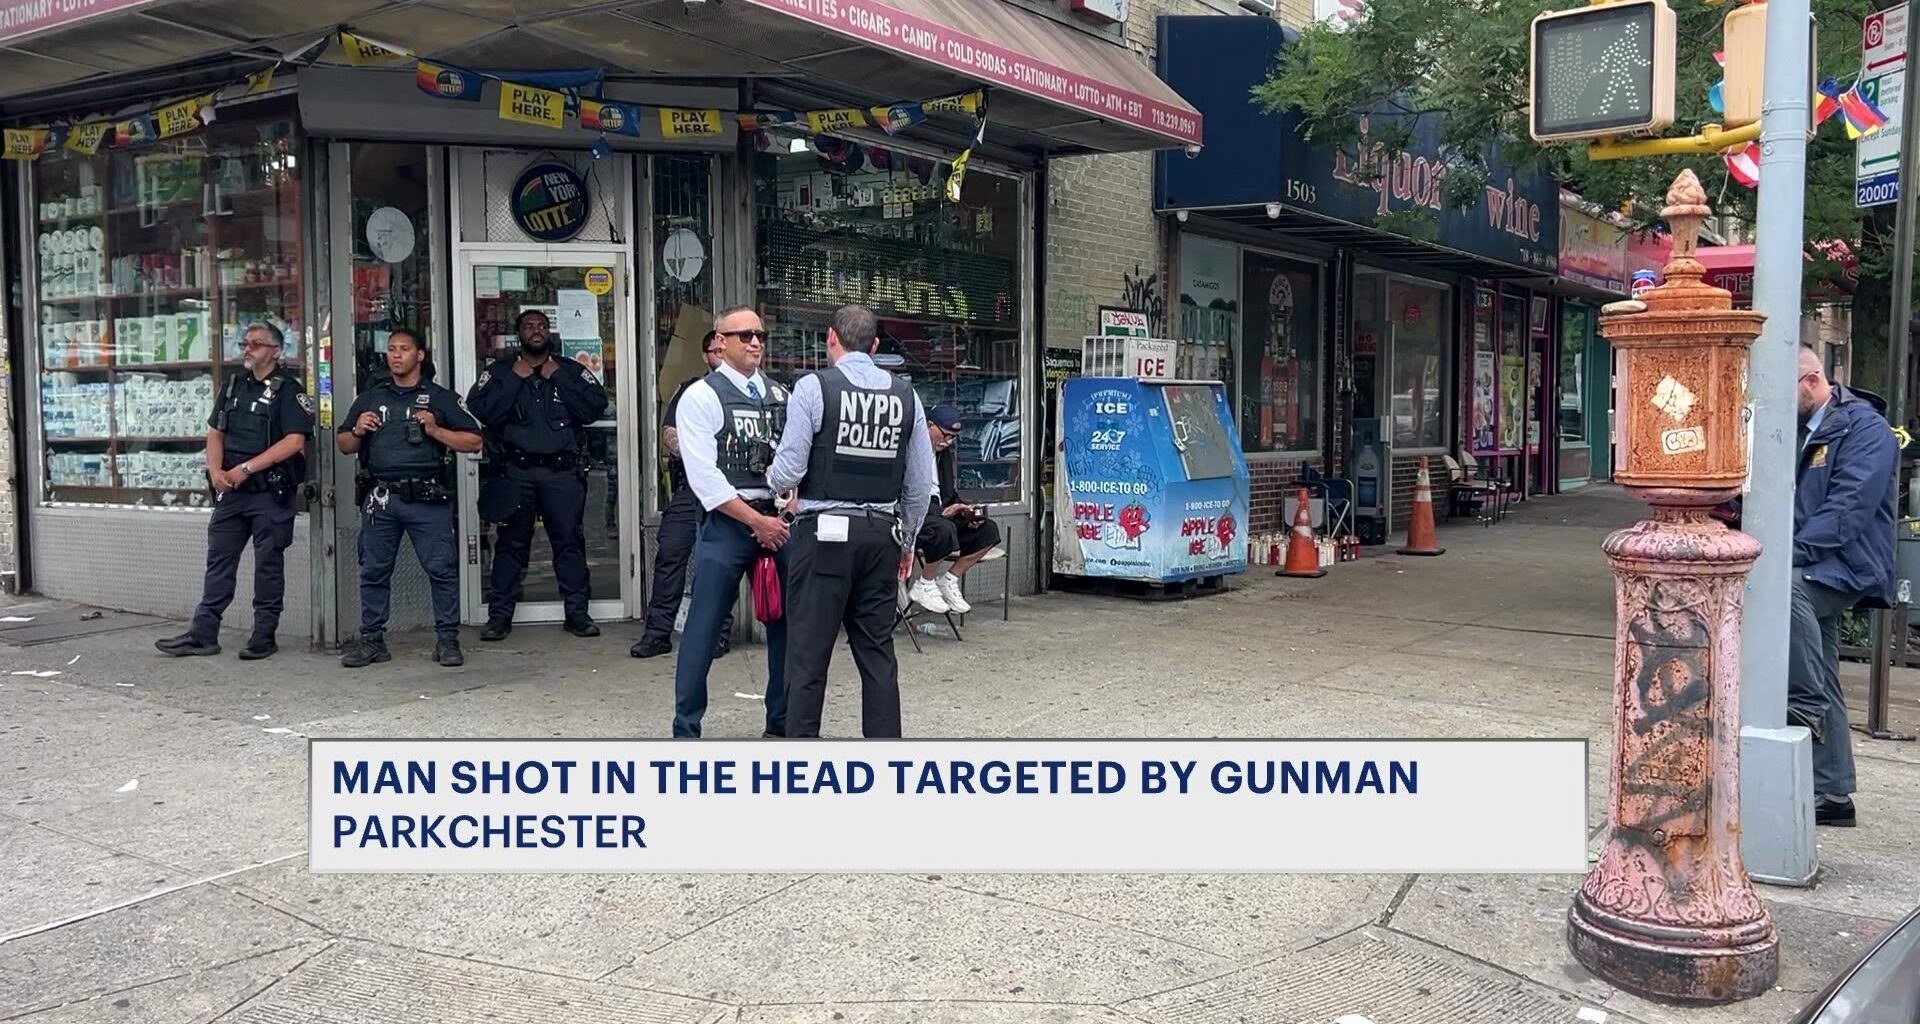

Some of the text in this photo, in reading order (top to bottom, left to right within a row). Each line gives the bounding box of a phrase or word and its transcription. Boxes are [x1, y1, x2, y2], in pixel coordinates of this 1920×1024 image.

[359, 44, 391, 58] HER
[849, 5, 891, 37] CIGARS
[901, 24, 938, 53] CANDY
[947, 39, 974, 65] COLD
[975, 50, 1007, 77] SODAS
[1014, 62, 1068, 95] STATIONARY
[1074, 86, 1100, 106] LOTTO
[1105, 93, 1122, 113] ATM
[1128, 100, 1143, 119] EBT
[1151, 108, 1196, 136] 718.239.0967
[513, 89, 551, 106] PLAY
[165, 105, 191, 121] PLAY
[512, 101, 555, 121] HERE.
[672, 111, 708, 122] PLAY
[818, 111, 851, 124] PLAY
[79, 124, 101, 137] PLAY
[75, 136, 101, 149] HER
[543, 172, 570, 188] NEW
[1287, 178, 1316, 204] 1503
[523, 201, 577, 233] LOTTE
[574, 309, 582, 317] A
[1137, 358, 1165, 377] ICE
[839, 390, 903, 426] NYPD
[1095, 402, 1128, 414] ICE
[734, 417, 772, 438] POL
[836, 421, 902, 450] POLICE
[1090, 443, 1121, 451] SERVICE
[1070, 480, 1148, 495] 1-800-ICE-TO GO
[1075, 501, 1115, 521] PPLE
[1181, 516, 1216, 537] APPLE
[1188, 537, 1207, 556] ICE
